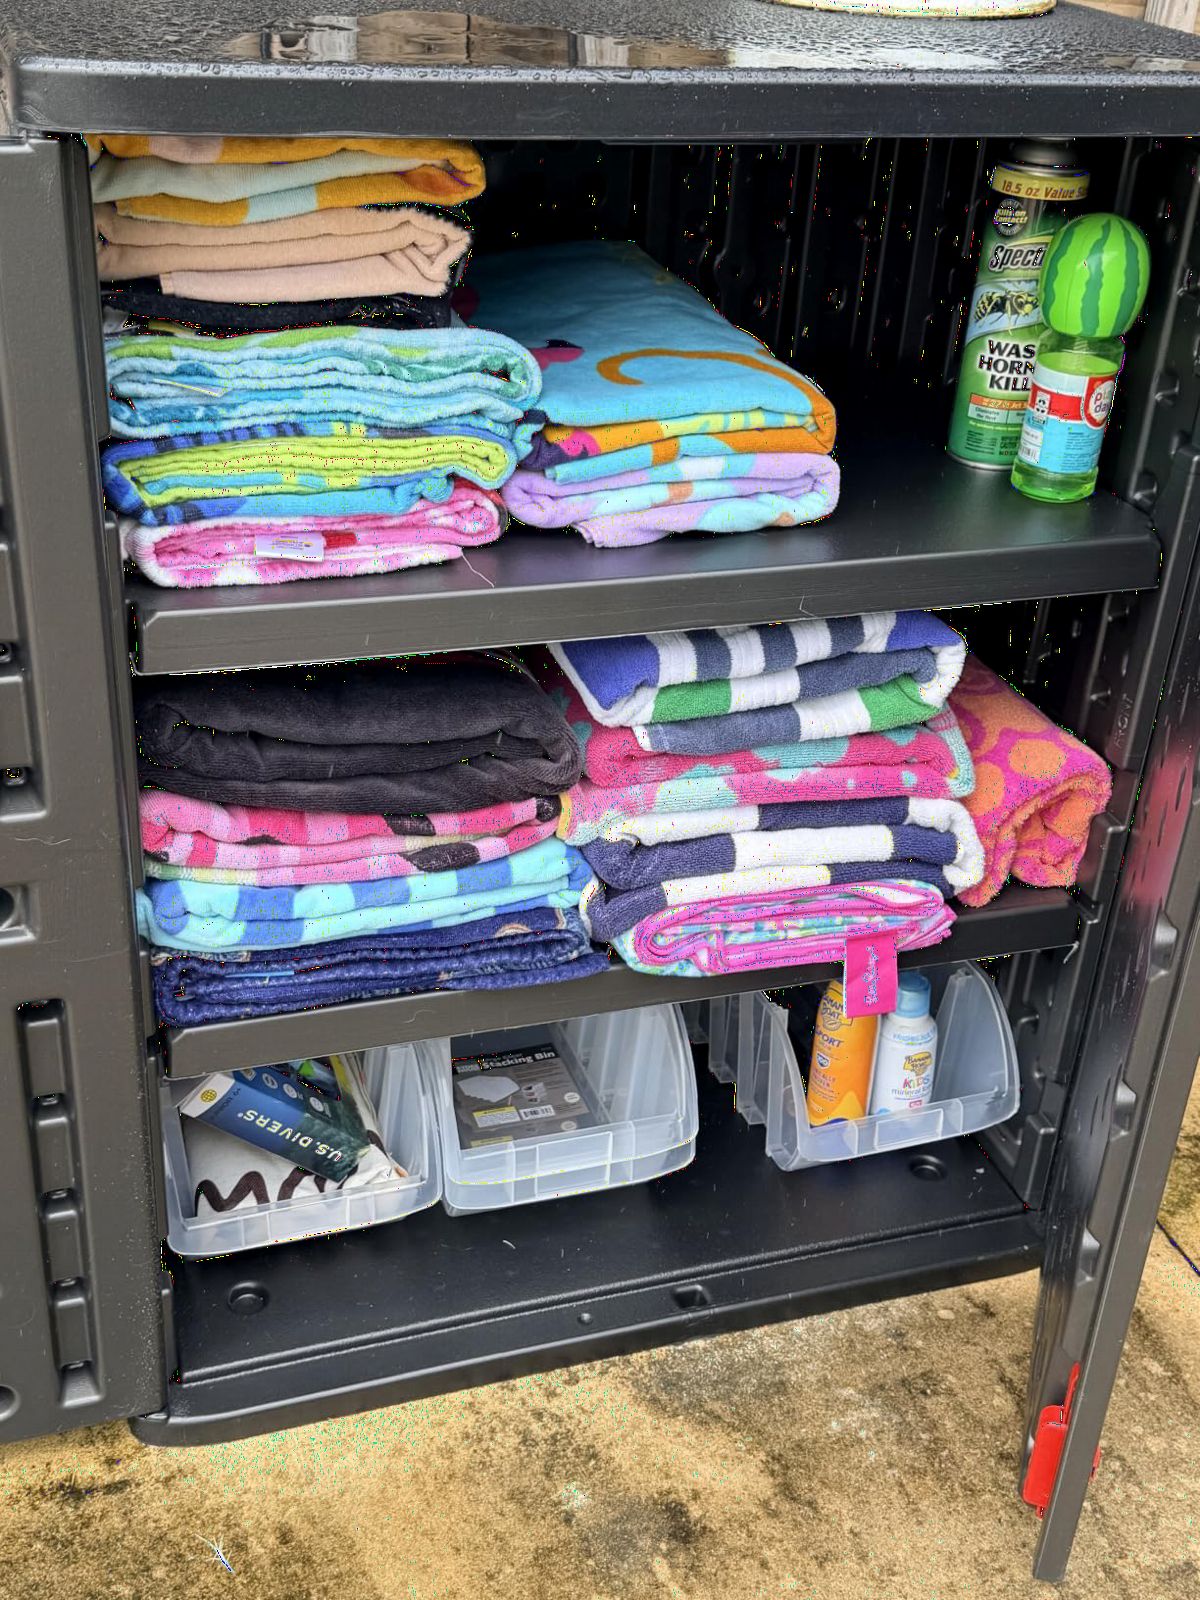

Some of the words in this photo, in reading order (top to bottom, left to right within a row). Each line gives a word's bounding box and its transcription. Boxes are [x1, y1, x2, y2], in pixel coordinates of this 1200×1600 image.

[1002, 179, 1023, 194] 18.5
[1025, 187, 1040, 197] oz
[1044, 186, 1076, 199] Value
[987, 339, 1036, 359] WAS
[978, 355, 1035, 375] HORN
[989, 374, 1031, 391] KILL
[482, 1055, 534, 1070] Stacking
[534, 1051, 556, 1060] Bin
[315, 1141, 343, 1163] U.S.
